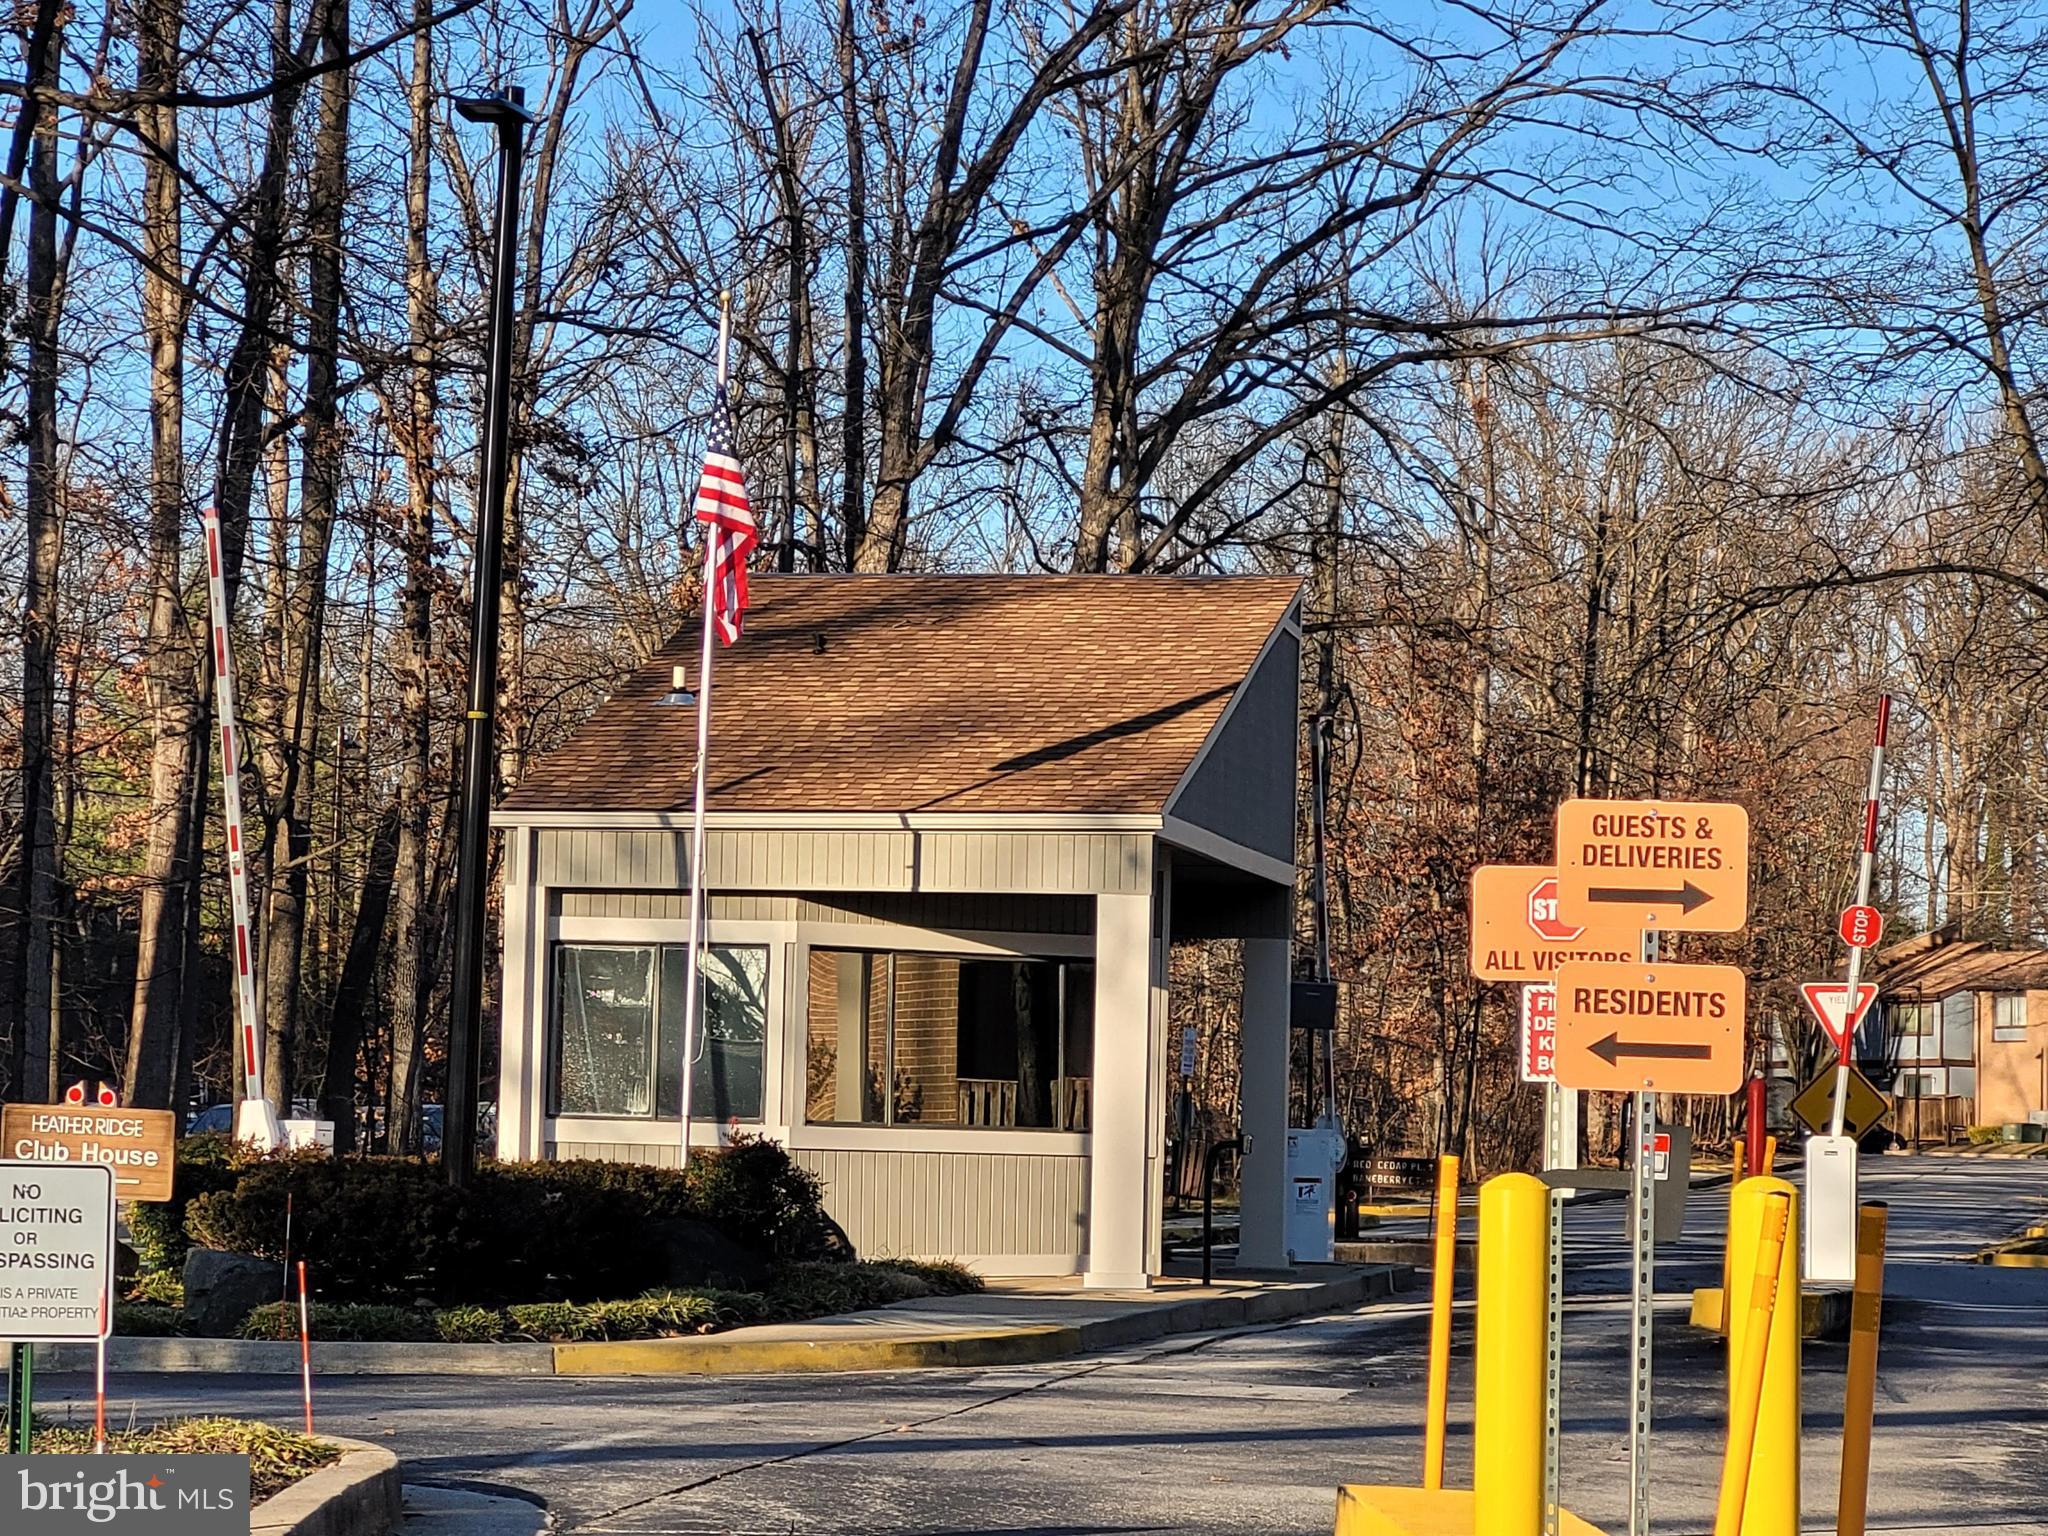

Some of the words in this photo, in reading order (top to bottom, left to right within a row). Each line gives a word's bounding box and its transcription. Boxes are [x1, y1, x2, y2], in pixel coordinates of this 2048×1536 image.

[1592, 814, 1686, 839] GUESTS
[1695, 817, 1713, 839] &
[1583, 844, 1722, 870] DELIVERIES
[1533, 898, 1558, 921] ST
[1852, 909, 1870, 944] STOP
[1485, 950, 1526, 970] ALL
[1538, 996, 1556, 1011] FI
[1574, 988, 1726, 1018] RESIDENTS
[1828, 995, 1848, 1005] YIEL
[31, 1114, 93, 1135] HEATHER
[95, 1118, 144, 1137] RIDGE
[15, 1139, 69, 1161] Club
[81, 1142, 159, 1166] House
[13, 1184, 41, 1200] NO
[14, 1231, 37, 1245] OR
[15, 1288, 24, 1299] A
[28, 1288, 78, 1300] PRIVATE
[31, 1307, 99, 1319] PROPERTY
